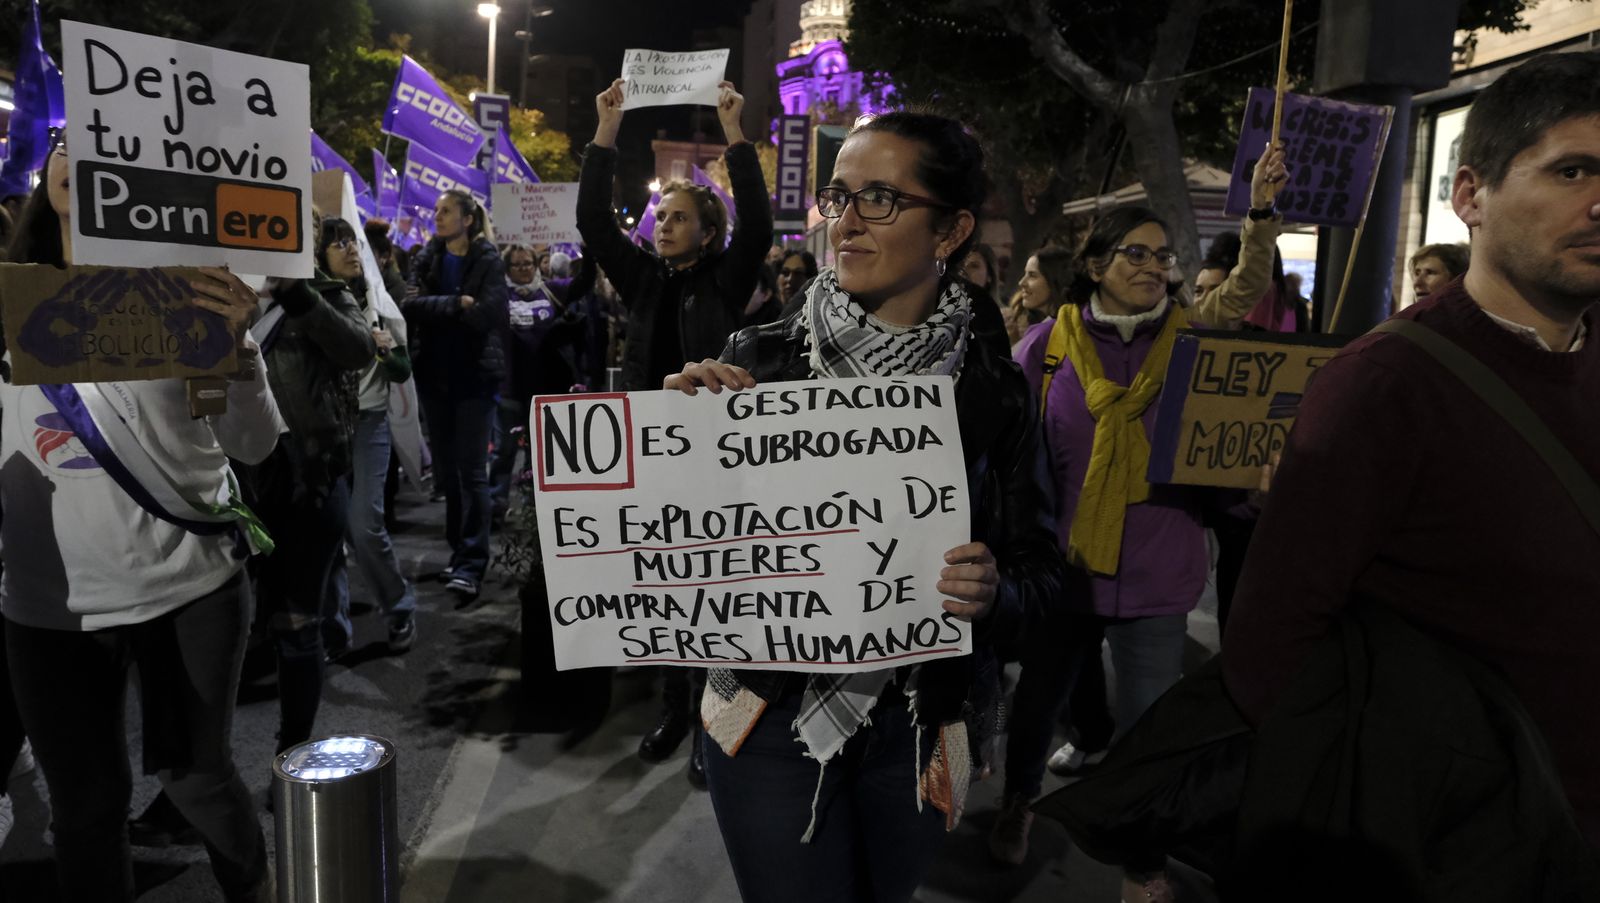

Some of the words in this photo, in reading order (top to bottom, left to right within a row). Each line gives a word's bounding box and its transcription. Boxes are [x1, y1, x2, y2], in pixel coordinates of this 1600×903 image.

[84, 38, 215, 135] Deja
[245, 78, 277, 117] a
[627, 65, 645, 76] ES
[86, 109, 141, 161] tu
[163, 143, 288, 180] novio
[779, 119, 804, 209] CCOO
[1319, 167, 1354, 190] DE
[1276, 190, 1349, 218] UJER
[1192, 349, 1288, 397] LEY
[726, 380, 942, 421] GESTACIÓN
[543, 402, 622, 477] NO
[641, 425, 692, 457] ES
[717, 424, 943, 469] SUBROGADA
[633, 544, 821, 581] MUJERES
[867, 538, 899, 576] Y
[858, 575, 917, 613] DE
[618, 625, 753, 663] SERES
[764, 611, 962, 662] HUMANOS
